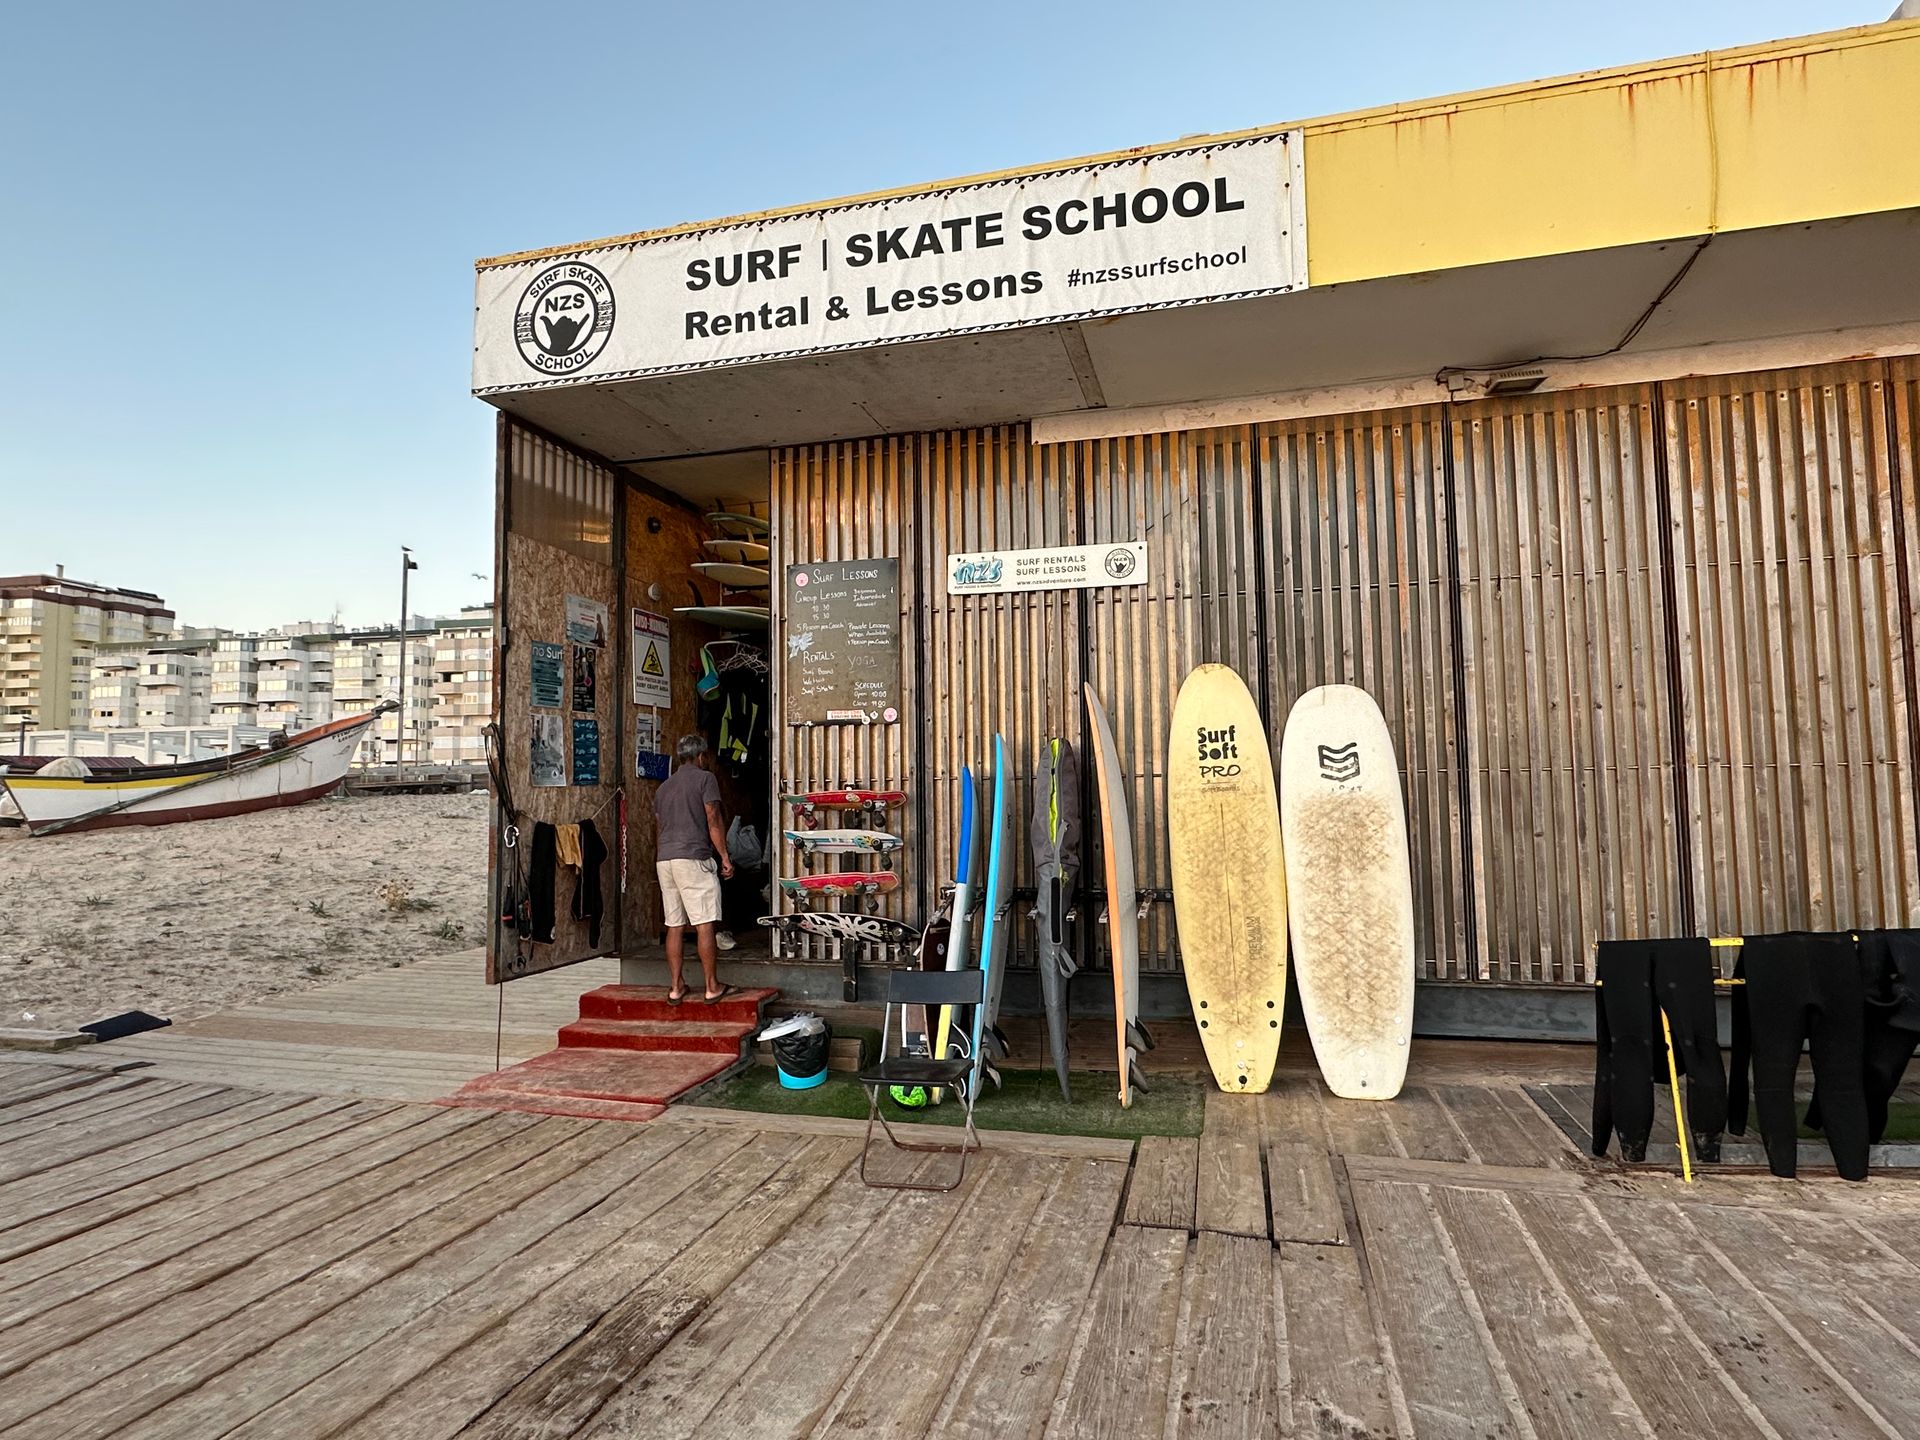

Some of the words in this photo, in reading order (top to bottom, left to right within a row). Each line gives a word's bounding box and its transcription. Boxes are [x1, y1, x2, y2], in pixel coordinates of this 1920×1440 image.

[685, 243, 802, 292] SURF
[845, 211, 1005, 268] SKATE
[1021, 176, 1245, 241] SCHOOL
[1067, 245, 1247, 288] #nzssurfschool
[529, 268, 561, 299] SURF
[568, 266, 605, 296] SKATE
[544, 292, 585, 313] NZS
[685, 296, 809, 340] Rental
[825, 295, 850, 322] &
[866, 269, 1044, 317] Lessons
[535, 348, 594, 370] SCHOOL
[1016, 558, 1040, 566] SURF
[1044, 555, 1086, 564] RENTALS
[1016, 567, 1040, 576] SURF
[1043, 564, 1087, 574] LESSONS
[1197, 724, 1236, 744] Surf
[1198, 742, 1238, 761] Soft
[1198, 764, 1242, 778] PRO
